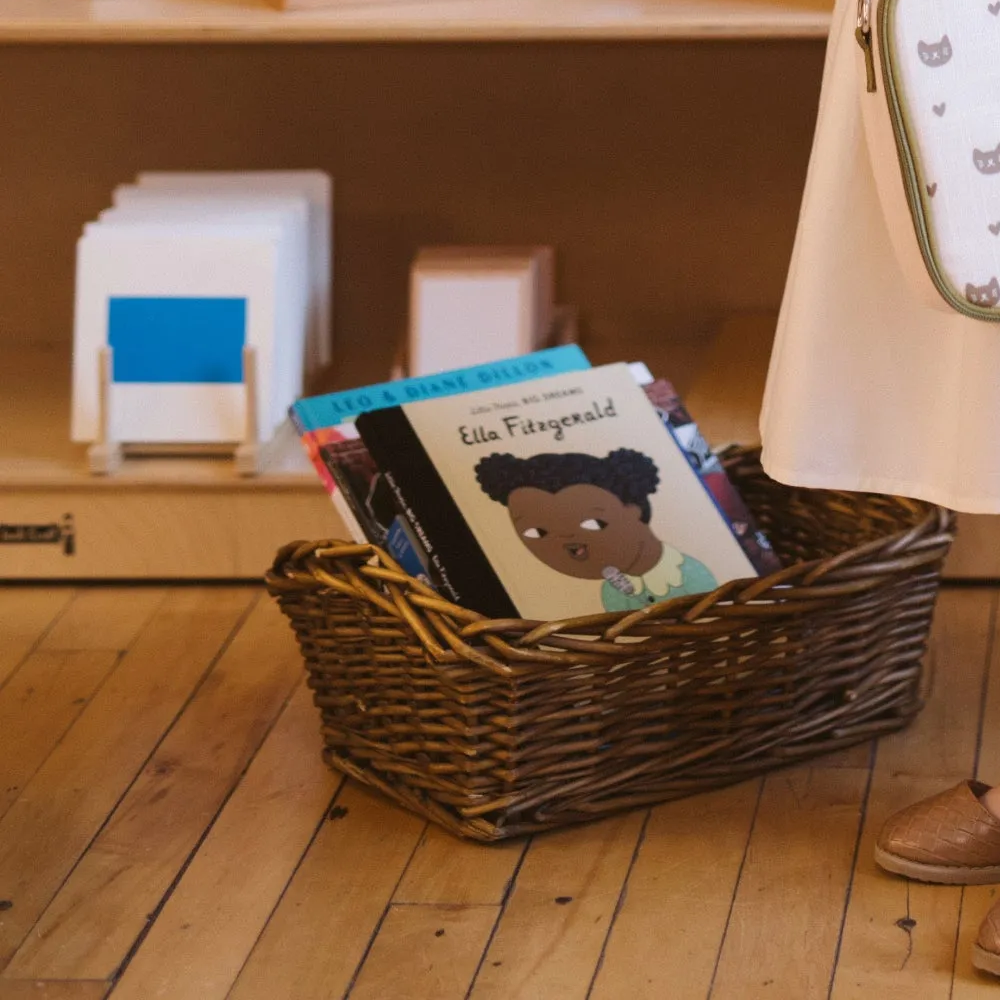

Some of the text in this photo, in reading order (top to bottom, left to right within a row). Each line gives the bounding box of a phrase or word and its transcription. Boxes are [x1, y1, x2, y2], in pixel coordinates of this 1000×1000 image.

[332, 394, 374, 414] LEO
[406, 376, 468, 399] DIANE
[478, 359, 555, 383] DILLON
[458, 424, 503, 446] Ella
[502, 397, 618, 442] Fitzgerald
